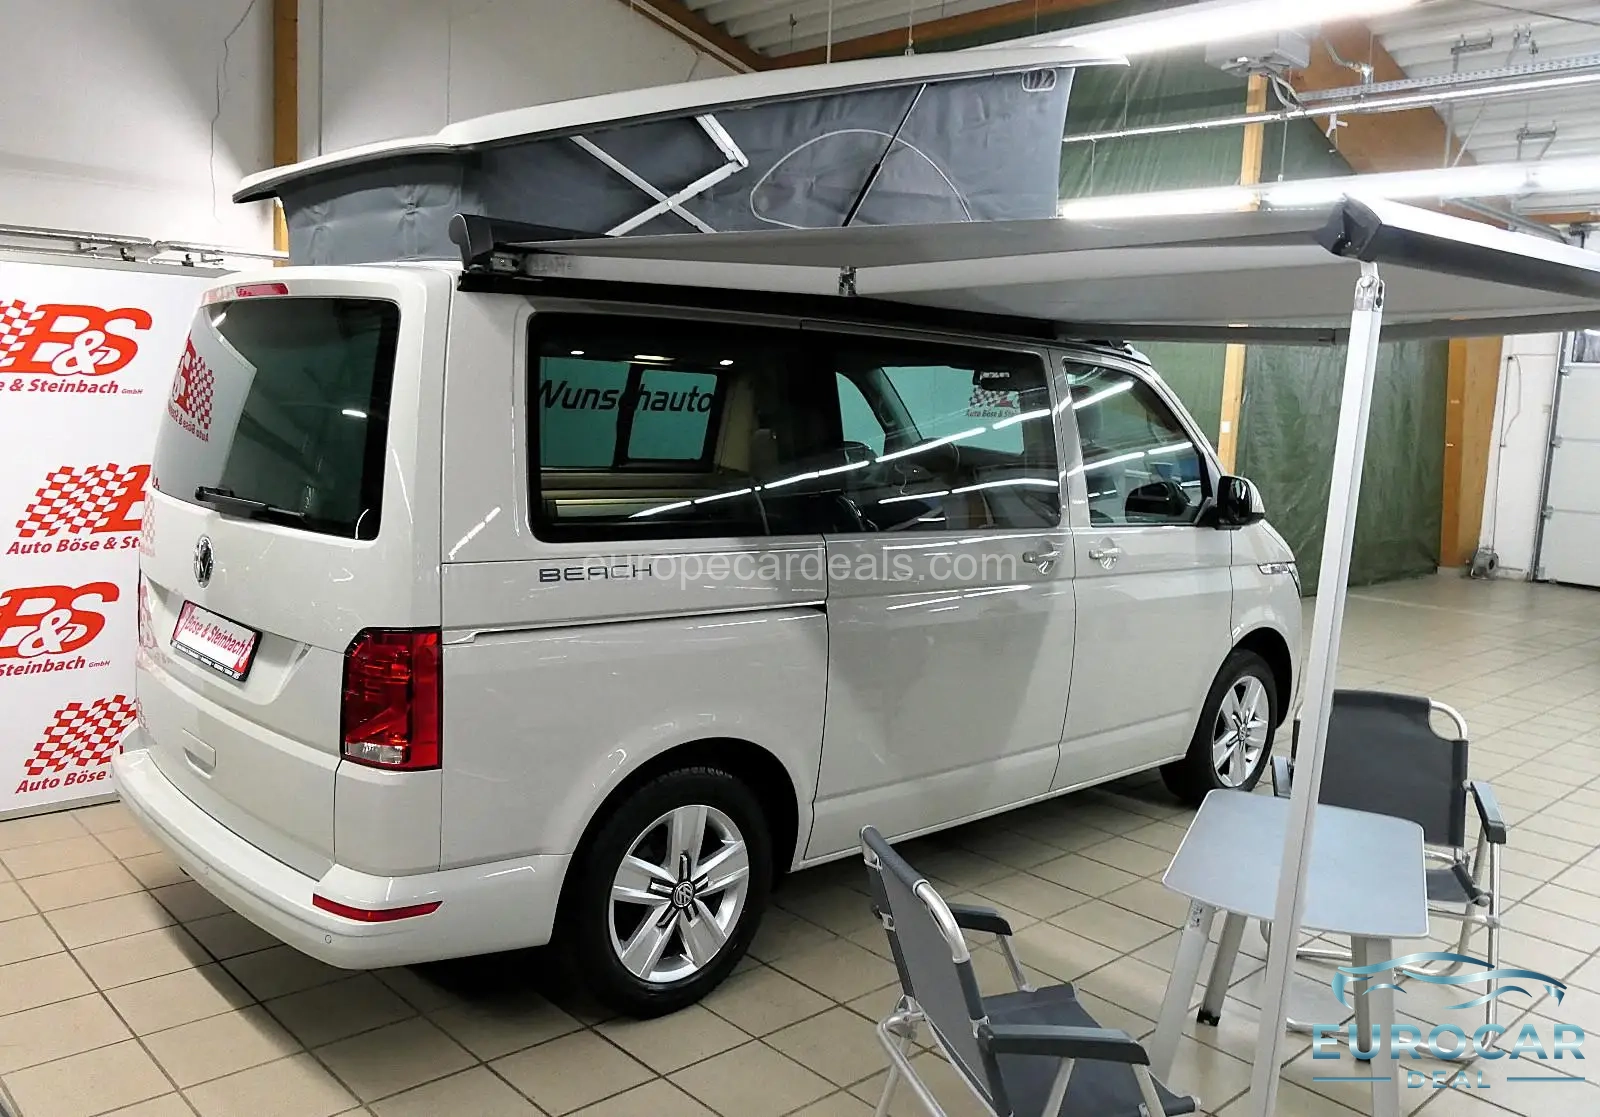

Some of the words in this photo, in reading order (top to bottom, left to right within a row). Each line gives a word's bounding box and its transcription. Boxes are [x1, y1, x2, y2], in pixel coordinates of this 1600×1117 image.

[9, 378, 25, 392] &
[28, 378, 119, 394] Steinbach
[539, 379, 714, 413] Wunshauto
[6, 541, 52, 555] Auto
[56, 538, 100, 553] Böse
[103, 537, 118, 550] &
[539, 563, 653, 582] BEACH
[207, 625, 246, 656] Steinbach
[0, 655, 86, 677] Steinbach
[88, 660, 111, 668] GmbH
[15, 778, 60, 794] Auto
[64, 770, 107, 786] Böse
